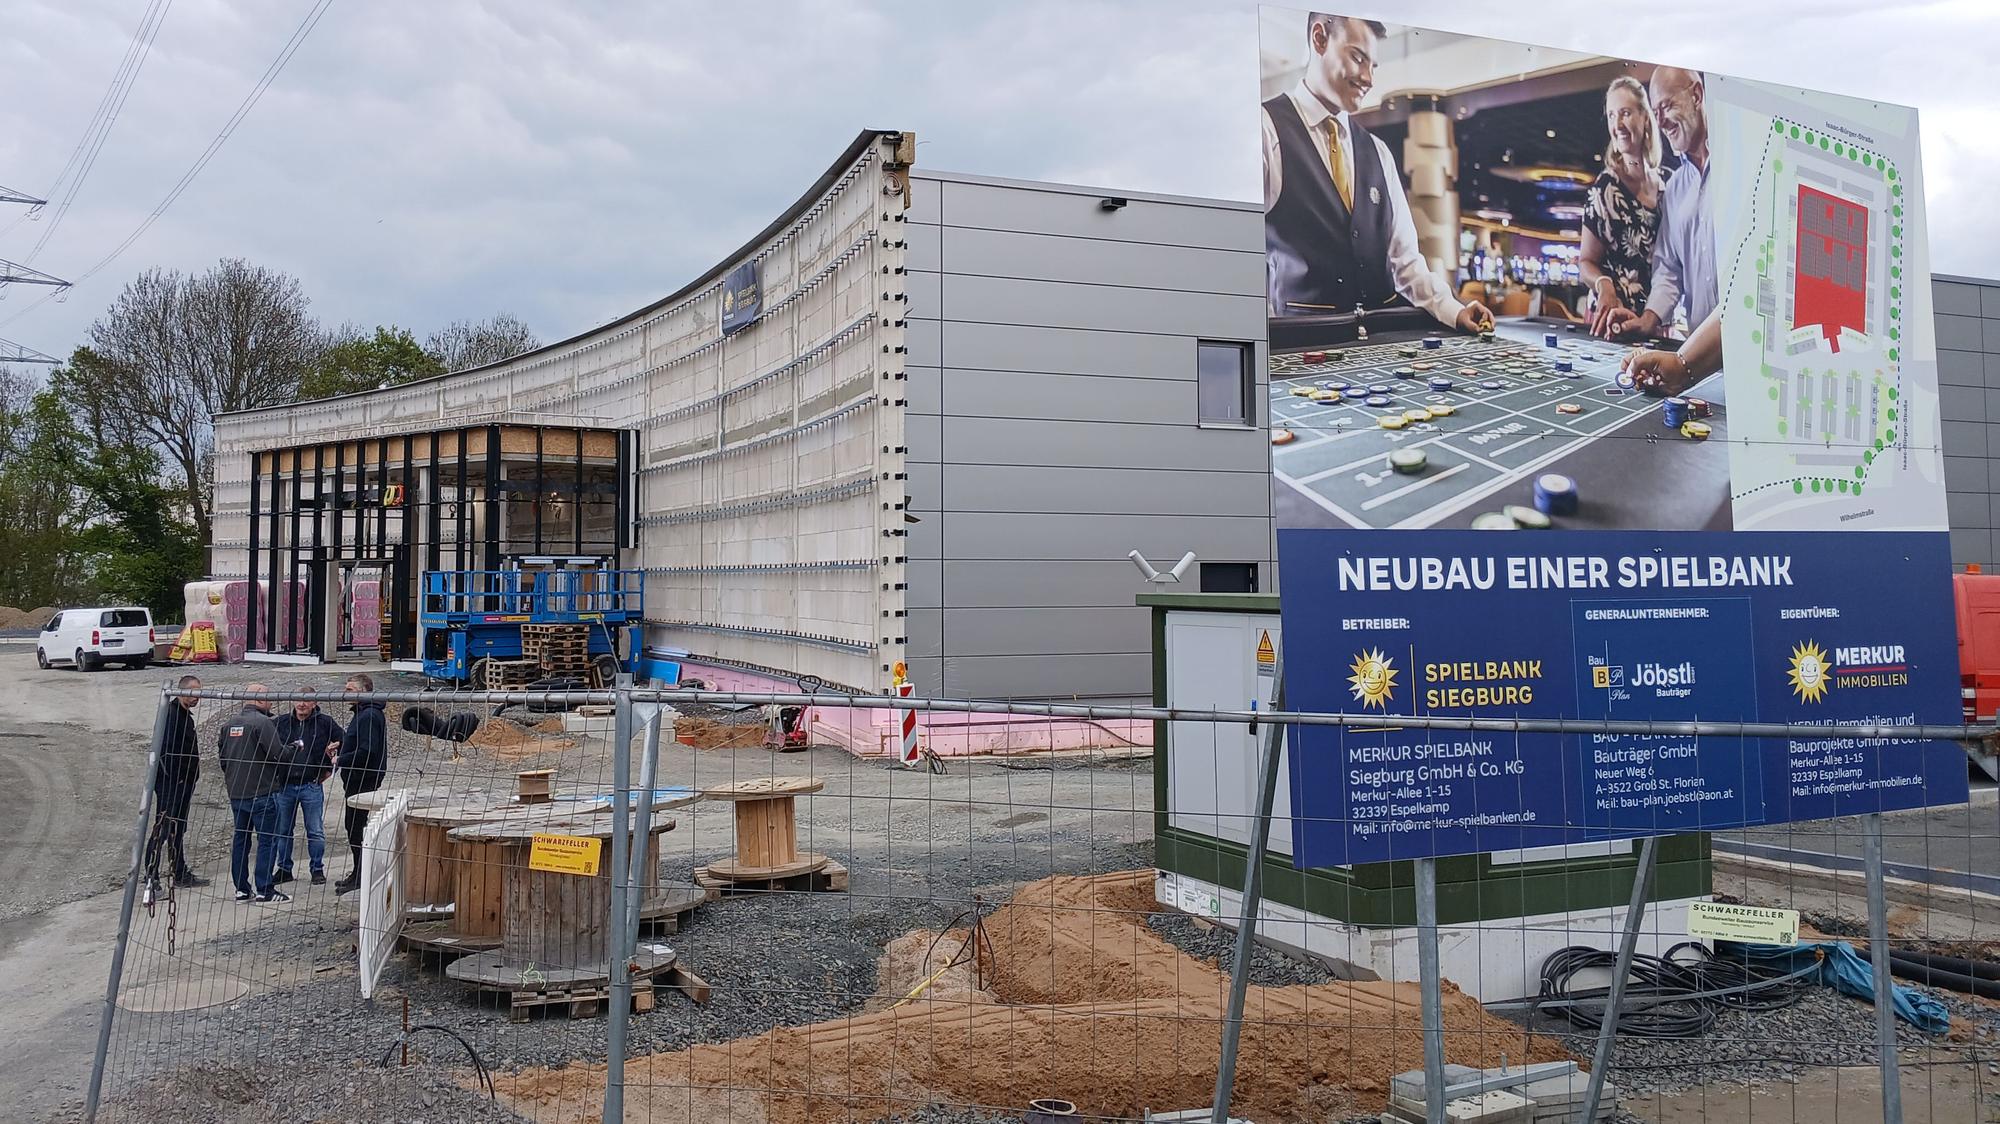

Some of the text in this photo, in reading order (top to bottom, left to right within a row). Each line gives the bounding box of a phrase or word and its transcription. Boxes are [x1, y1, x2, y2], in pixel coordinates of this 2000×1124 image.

[1338, 555, 1794, 591] NEUBAU EINER SPIELBANK
[1585, 607, 1710, 620] GENERALUNTERNEHMER:
[1780, 606, 1840, 619] EIGENTÜMER:
[1342, 618, 1411, 630] BETREIBER:
[1588, 655, 1604, 665] Bau
[1835, 645, 1906, 666] MERKUR
[1425, 660, 1543, 682] SPIELBANK
[1631, 662, 1691, 687] Jöbstl
[1836, 674, 1908, 688] IMMOBILIEN
[1426, 685, 1533, 708] SIEGBURG
[1610, 689, 1630, 700] Plan
[1656, 688, 1691, 698] Bauträger
[1895, 713, 1915, 726] und
[1350, 741, 1493, 763] MERKUR SPIELBANK
[1789, 738, 1854, 755] Bauprojekte
[1594, 743, 1697, 765] Bauträger GmbH
[1844, 753, 1864, 764] 1-15
[1350, 759, 1525, 788] Siegburg GmbH & Co. KG
[1595, 766, 1655, 779] Neuer Weg 6
[1791, 767, 1863, 783] 32339 Espelkamp
[1633, 779, 1657, 791] Groß
[1658, 778, 1673, 790] St.
[1674, 776, 1705, 789] Florian
[1351, 785, 1451, 803] Merkur-Allee 1-15
[1792, 785, 1811, 797] Mail:
[1352, 801, 1450, 819] 32339 Espelkamp
[1596, 798, 1619, 810] Mail:
[1352, 822, 1378, 835] Mail:
[533, 836, 589, 848] SCHWARZFELLER
[1693, 904, 1784, 919] SCHWARZFELLER
